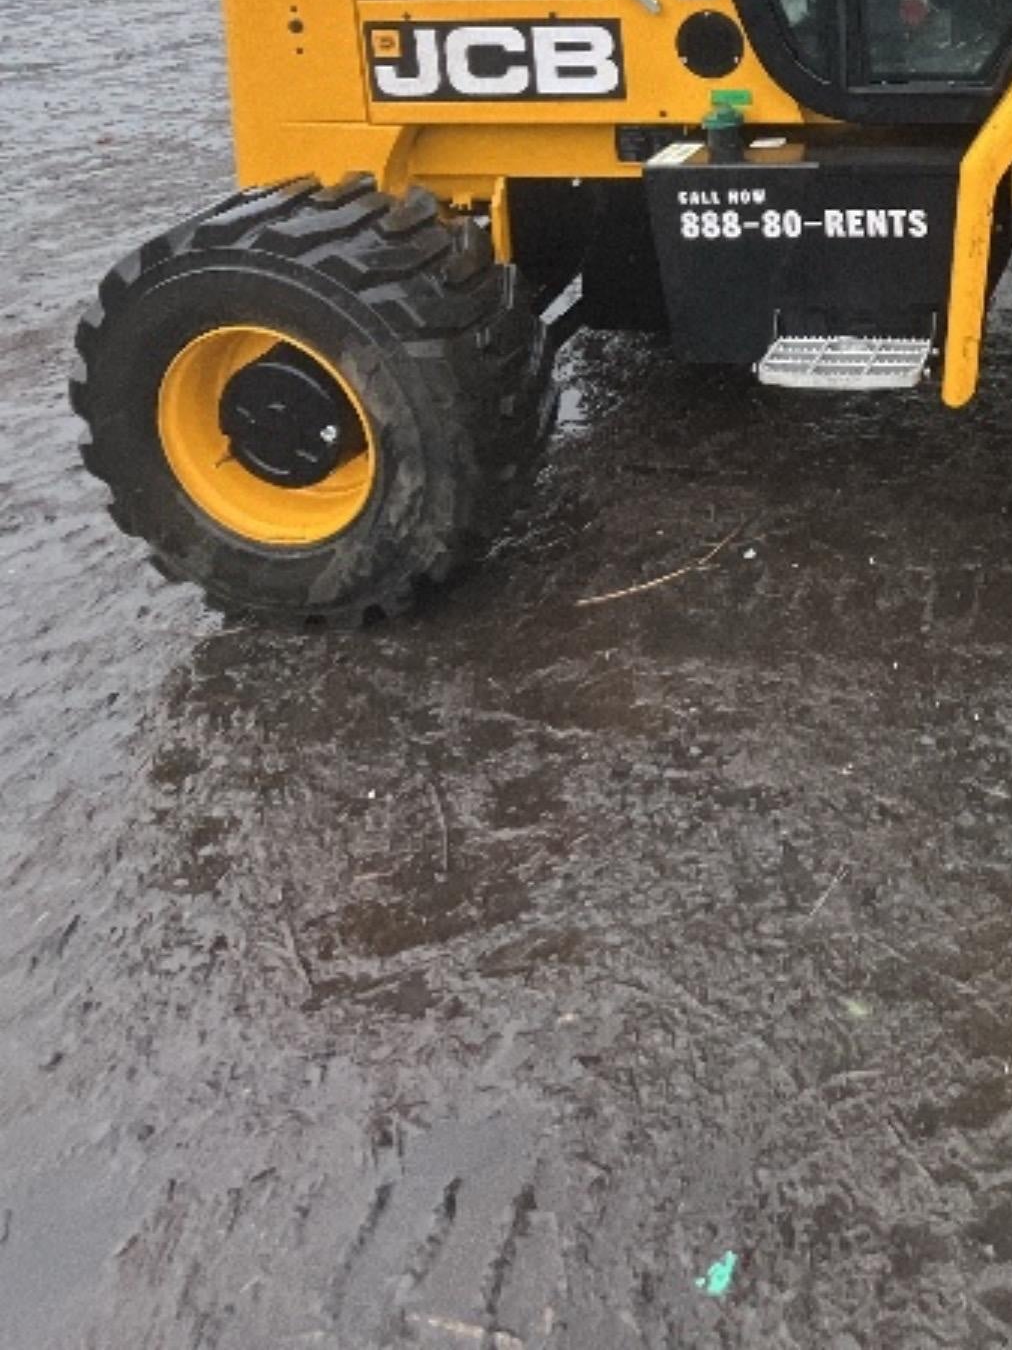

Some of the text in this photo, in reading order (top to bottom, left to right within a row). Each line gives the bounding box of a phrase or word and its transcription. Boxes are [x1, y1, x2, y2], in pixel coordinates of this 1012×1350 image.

[374, 26, 619, 96] JCB
[677, 188, 766, 205] CALL NOW
[680, 209, 929, 238] 888-80-RENTS
